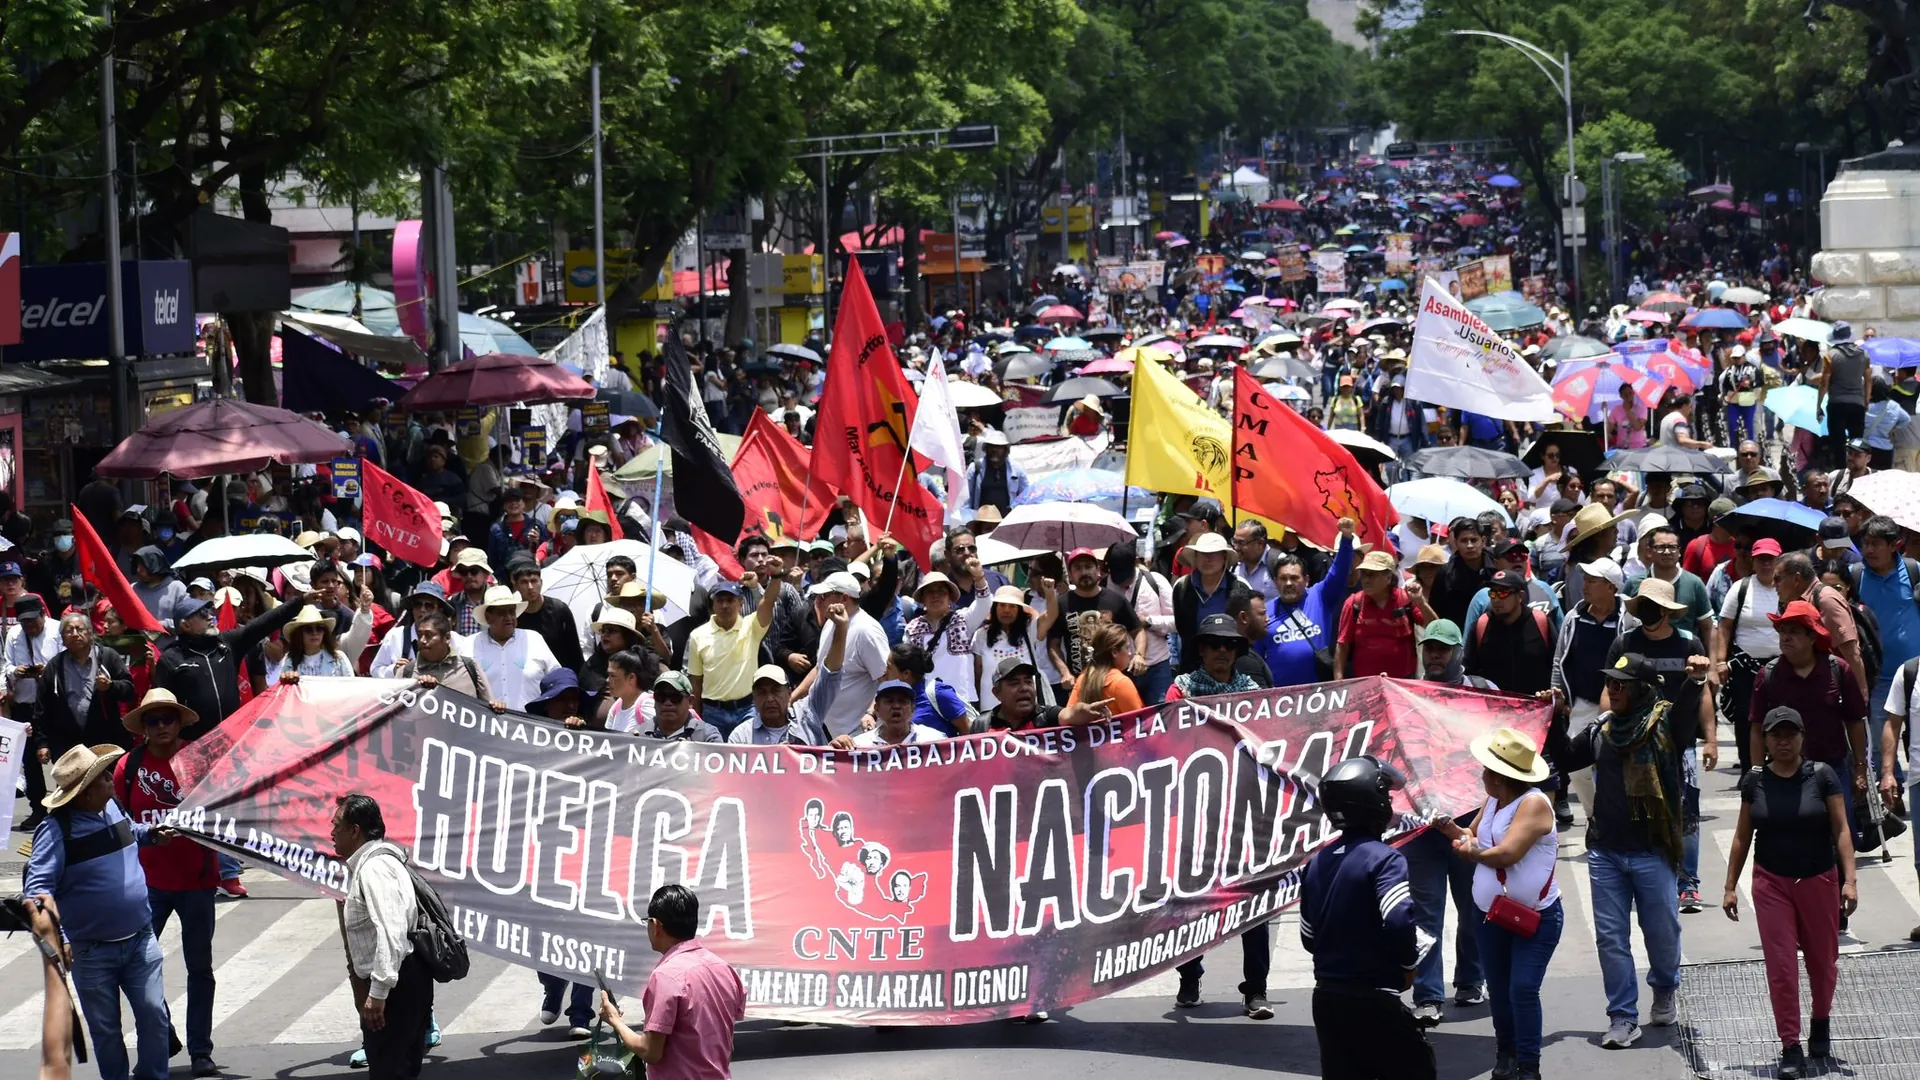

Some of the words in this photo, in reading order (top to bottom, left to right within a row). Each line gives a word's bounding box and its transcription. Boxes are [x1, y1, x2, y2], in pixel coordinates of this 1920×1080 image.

[154, 289, 179, 325] telcel
[1424, 295, 1489, 334] Asamblea
[858, 334, 885, 369] artido
[1460, 325, 1516, 360] Usuarios
[1235, 392, 1270, 483] CMAP
[375, 519, 421, 548] CNTE
[1273, 625, 1321, 644] adidas
[379, 689, 614, 760] COORDINADORA
[628, 744, 785, 775] NACIONAL
[800, 750, 835, 775] DE
[852, 729, 1076, 773] TRABAJADORES
[1089, 721, 1122, 748] DE
[1135, 712, 1166, 739] LA
[1178, 687, 1348, 729] EDUCACIÓN
[141, 808, 172, 829] CN
[411, 736, 754, 941] HUELGA
[243, 827, 350, 894] ABROGACI
[453, 905, 489, 943] LEY
[496, 918, 532, 958] DEL
[539, 931, 625, 981] ISSSTE!
[792, 926, 924, 962] CNTE
[1093, 911, 1221, 983] ¡ABROGACIÓN
[1221, 899, 1247, 936] DE
[1246, 889, 1270, 922] LA
[740, 968, 828, 1008] EMENTO
[836, 971, 944, 1009] SALARIAL
[953, 964, 1028, 1008] DIGNO!
